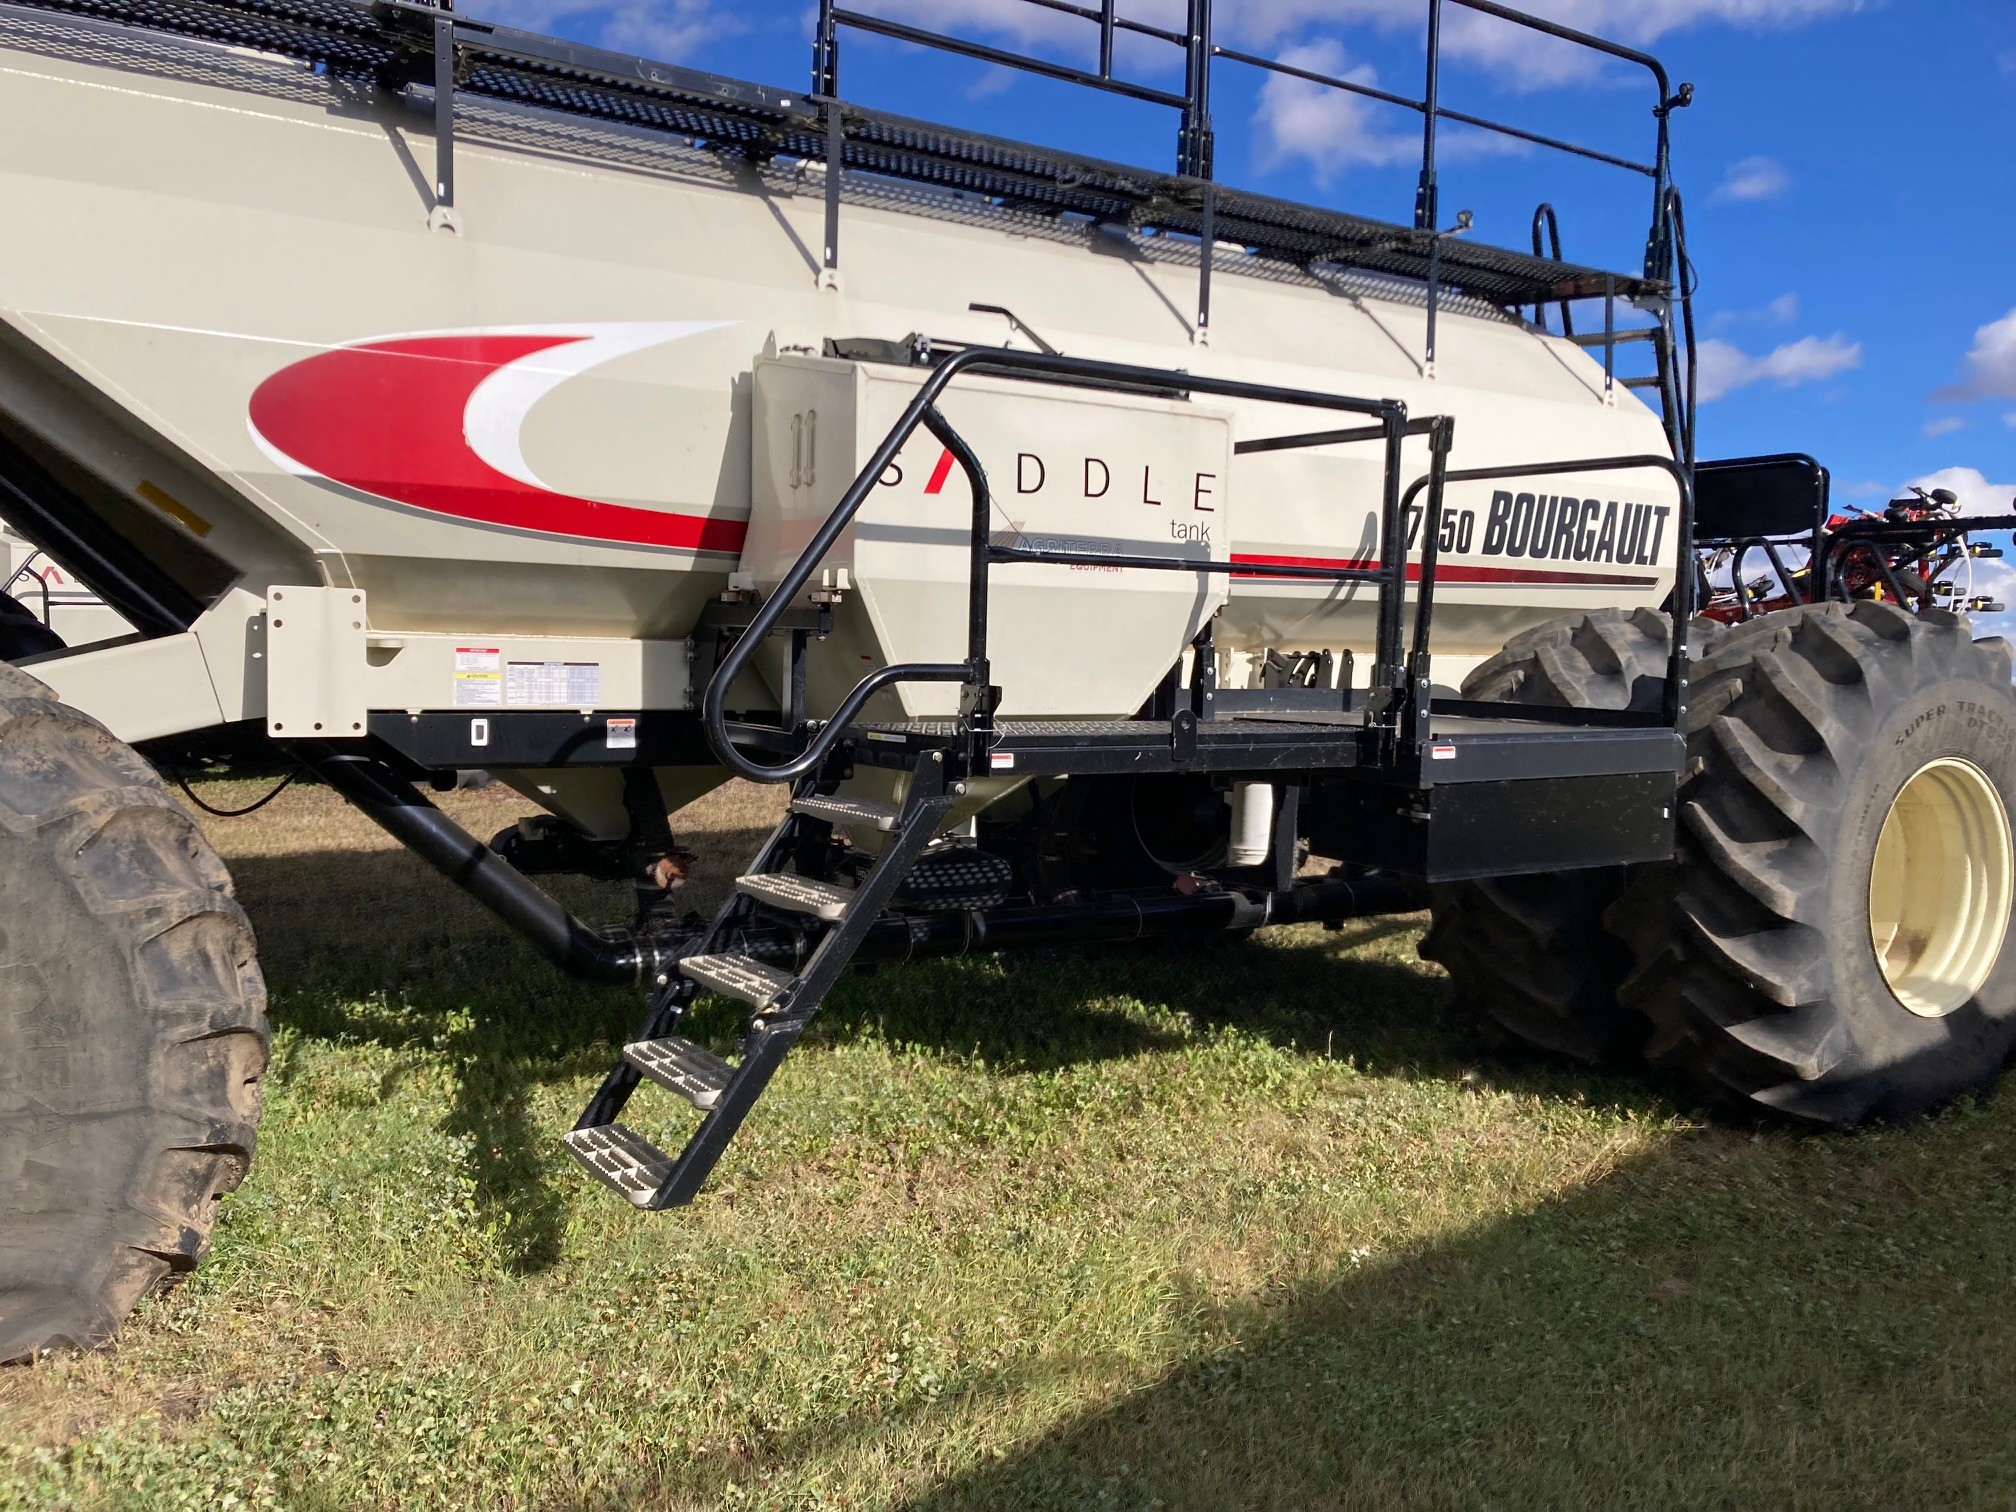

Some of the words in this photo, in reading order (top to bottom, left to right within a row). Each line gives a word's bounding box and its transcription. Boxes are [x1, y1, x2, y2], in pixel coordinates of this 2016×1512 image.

[1170, 519, 1211, 541] tank
[1407, 505, 1475, 554] 750
[1482, 490, 1671, 566] BOURGAULT
[1895, 704, 1946, 749] SUPER
